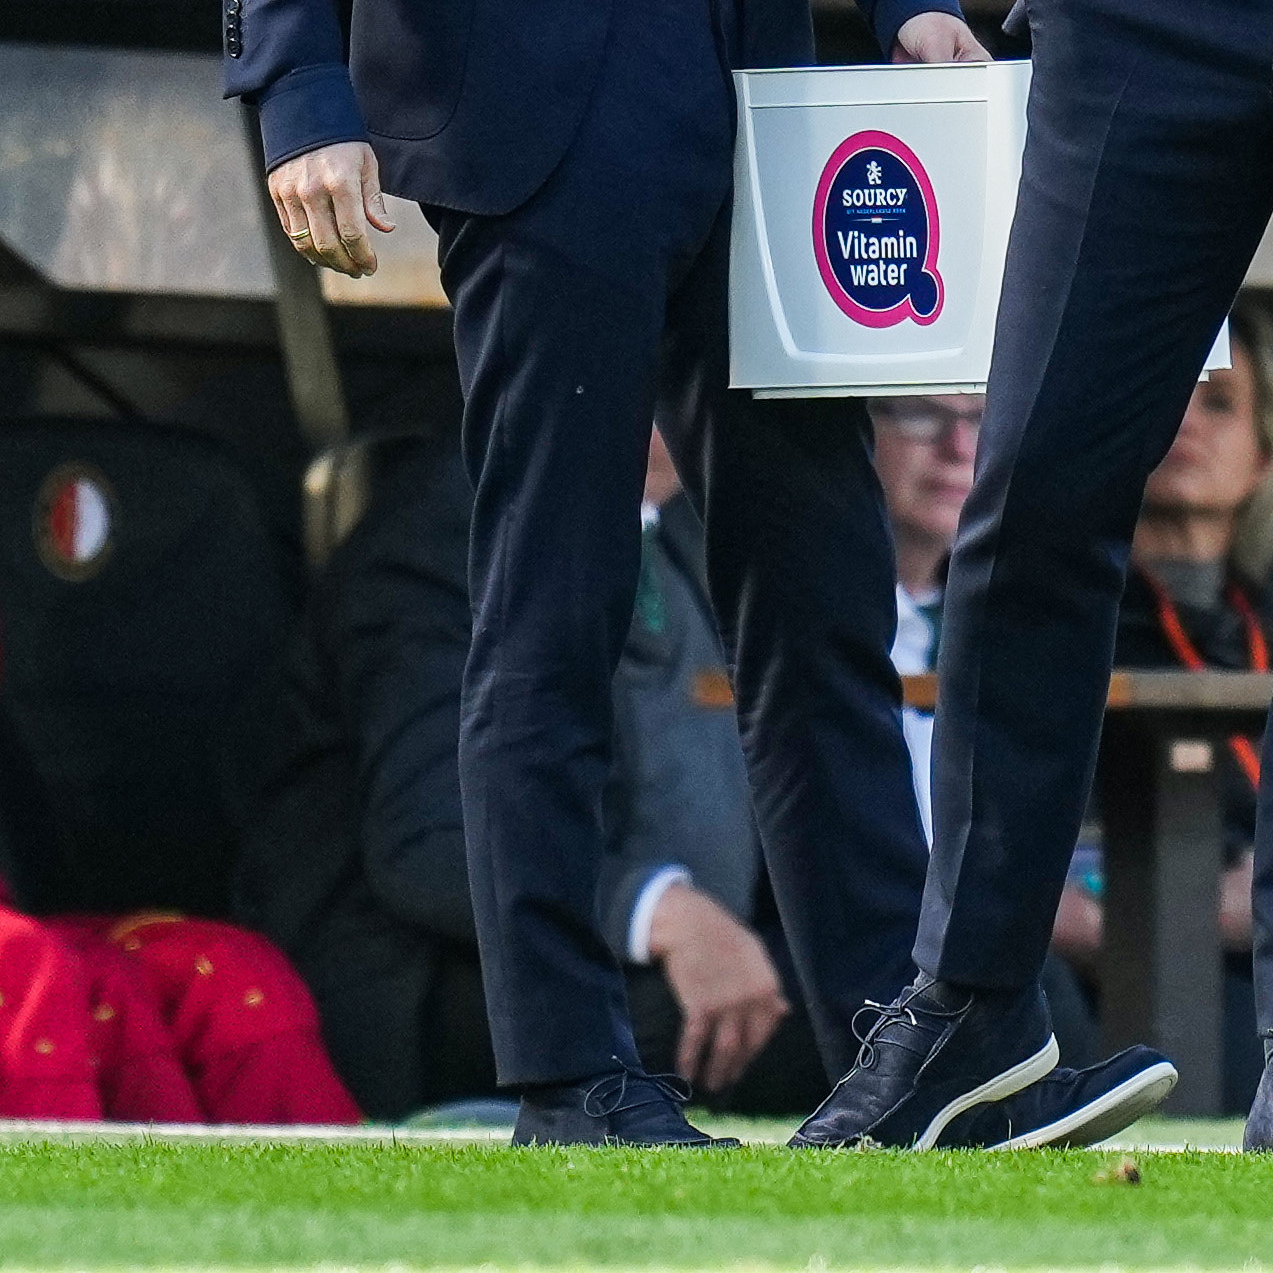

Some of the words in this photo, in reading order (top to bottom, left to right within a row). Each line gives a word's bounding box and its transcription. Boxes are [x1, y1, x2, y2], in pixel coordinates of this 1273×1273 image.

[842, 188, 908, 207] SOURCY
[837, 229, 918, 260] Vitamin
[849, 259, 908, 286] water
